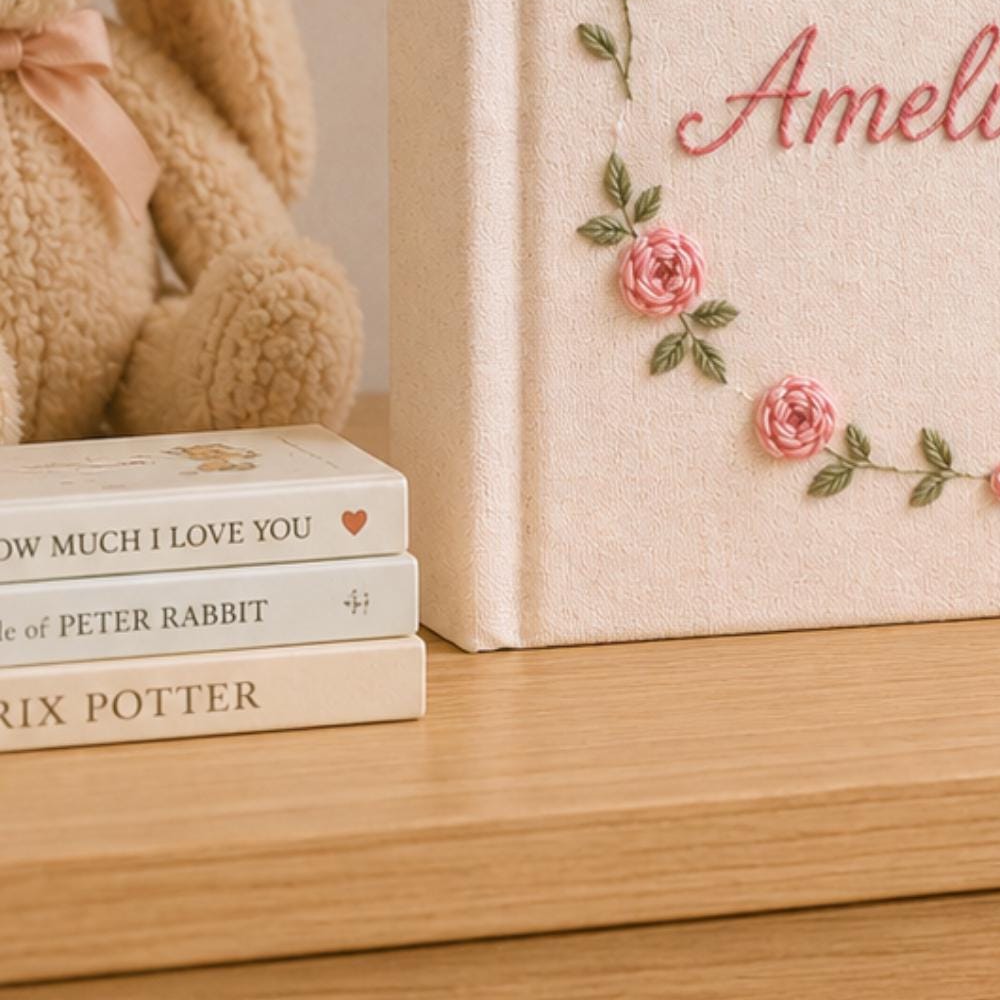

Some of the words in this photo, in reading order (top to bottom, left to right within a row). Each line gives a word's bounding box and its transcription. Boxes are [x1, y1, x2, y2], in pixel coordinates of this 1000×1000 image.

[51, 528, 141, 557] MUCH
[151, 528, 160, 550] I
[170, 521, 244, 548] LOVE
[253, 516, 312, 542] YOU
[25, 616, 50, 640] of
[59, 608, 151, 637] PETER
[161, 599, 269, 629] RABBIT
[86, 680, 261, 723] POTTER
